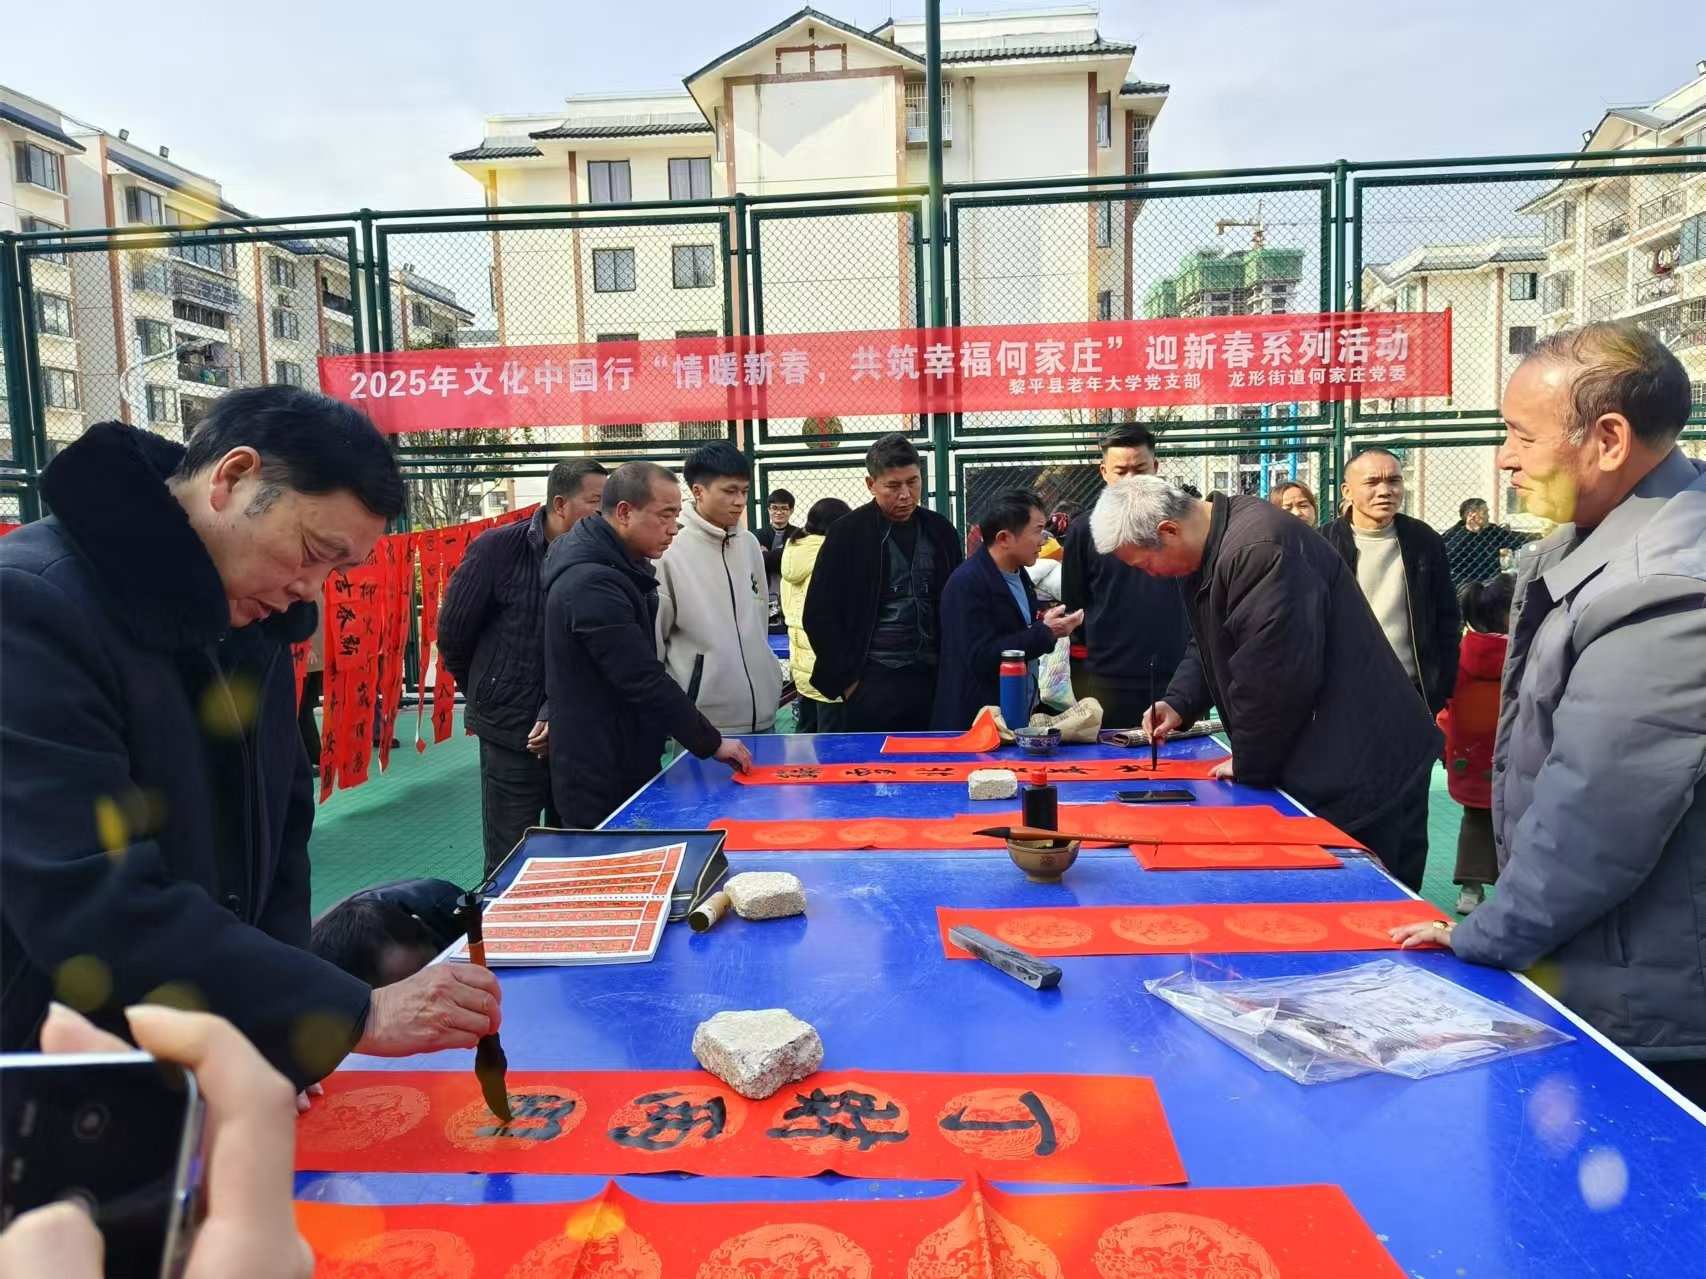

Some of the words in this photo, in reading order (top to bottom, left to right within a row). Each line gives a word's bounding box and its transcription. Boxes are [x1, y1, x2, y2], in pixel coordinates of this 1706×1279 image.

[1009, 372, 1202, 396] 黎平县老年大学党支部
[1228, 365, 1407, 389] 龙形街道何家庄党委
